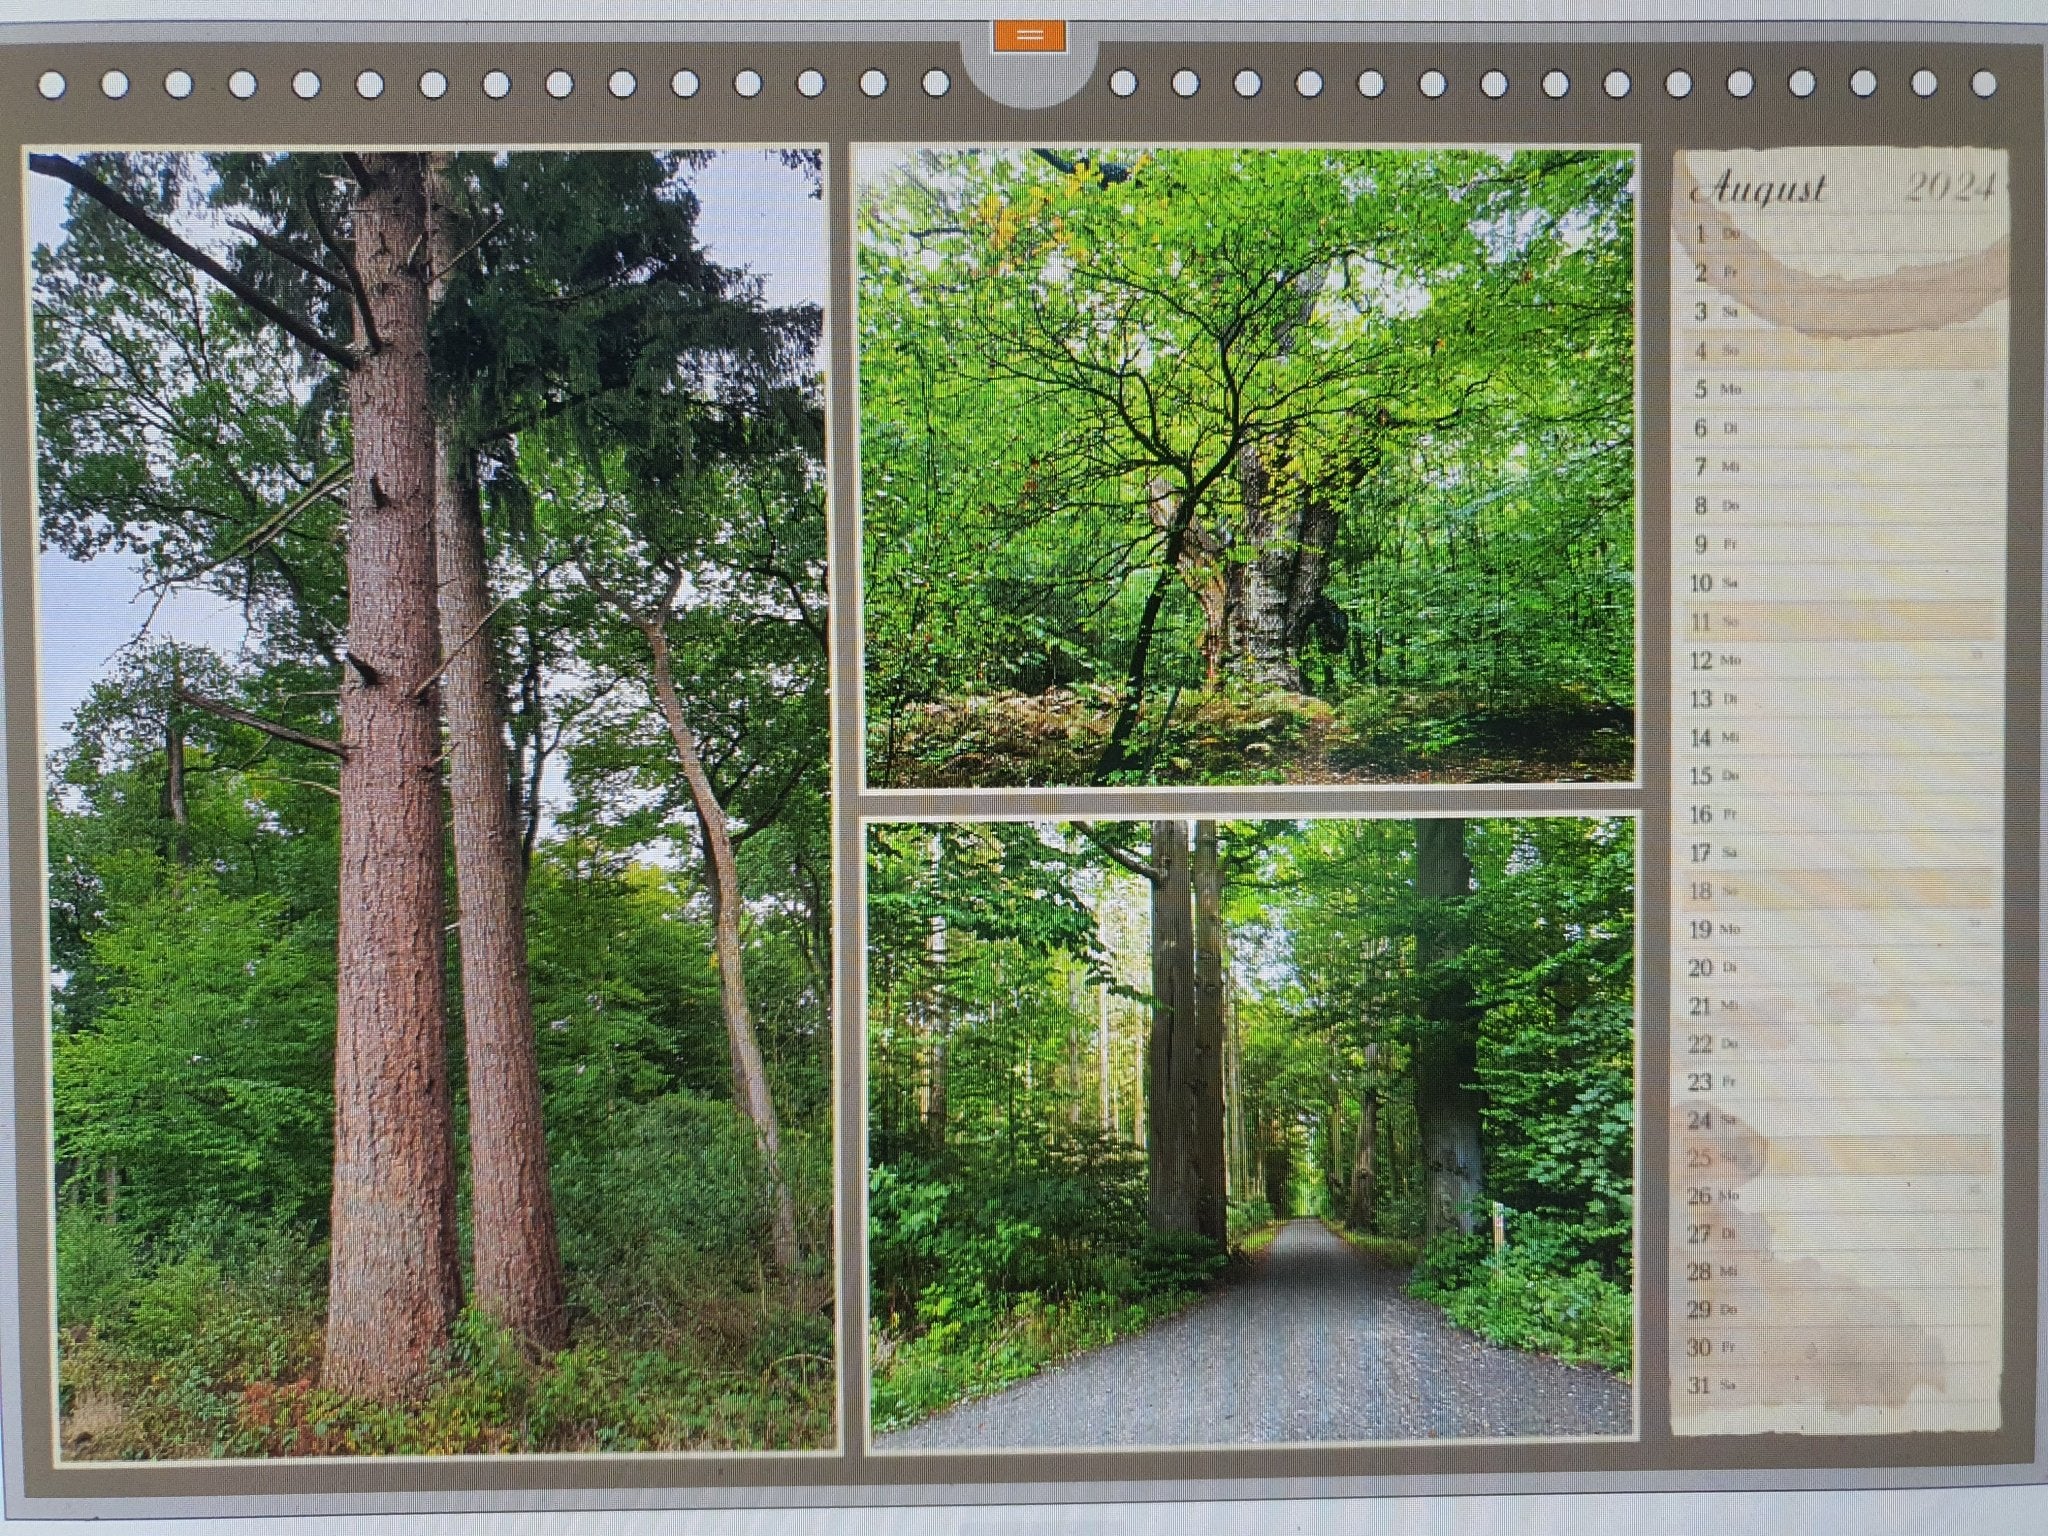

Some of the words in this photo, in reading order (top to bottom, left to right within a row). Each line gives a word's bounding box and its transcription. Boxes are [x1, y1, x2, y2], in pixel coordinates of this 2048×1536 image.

[1690, 168, 1828, 209] August
[1903, 171, 2000, 203] 2024
[1696, 223, 1706, 244] 1
[1694, 263, 1707, 282] 2
[1694, 302, 1707, 321] 3
[1695, 342, 1707, 361] 4
[1694, 379, 1707, 399] 5
[1694, 417, 1707, 439] 6
[1694, 456, 1707, 477] 7
[1694, 495, 1707, 516] 8
[1694, 534, 1707, 555] 9
[1691, 573, 1713, 593] 10
[1691, 612, 1710, 632] 11
[1691, 650, 1713, 670] 12
[1691, 688, 1713, 709] 13
[1691, 728, 1712, 748] 14
[1691, 766, 1713, 786] 15
[1691, 804, 1713, 824] 16
[1691, 842, 1712, 863] 17
[1690, 881, 1713, 901] 18
[1690, 919, 1713, 940] 19
[1688, 958, 1713, 978] 20
[1688, 996, 1711, 1016] 21
[1688, 1034, 1713, 1054] 22
[1687, 1072, 1712, 1092] 23
[1687, 1109, 1712, 1130] 24
[1687, 1147, 1712, 1168] 25
[1687, 1186, 1711, 1206] 26
[1687, 1223, 1711, 1243] 27
[1686, 1261, 1711, 1282] 28
[1686, 1299, 1711, 1319] 29
[1686, 1337, 1711, 1357] 30
[1687, 1376, 1710, 1394] 31
